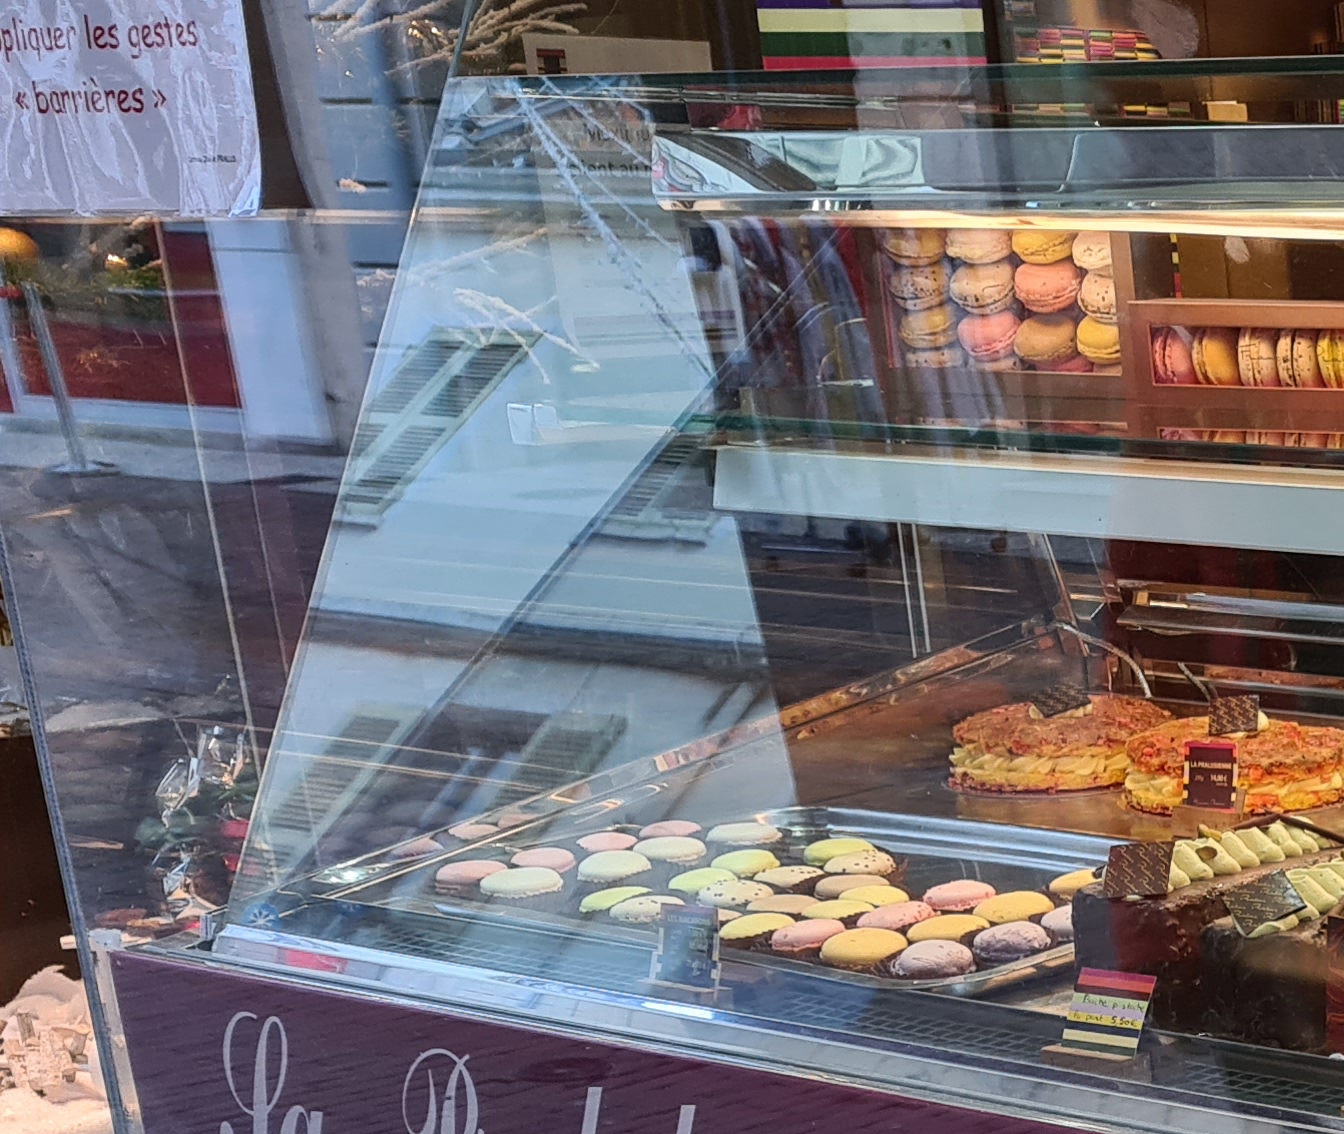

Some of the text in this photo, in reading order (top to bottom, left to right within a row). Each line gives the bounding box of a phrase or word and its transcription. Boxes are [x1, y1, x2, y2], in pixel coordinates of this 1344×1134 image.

[0, 14, 199, 62] pliquer les gestes
[32, 76, 146, 114] barrières
